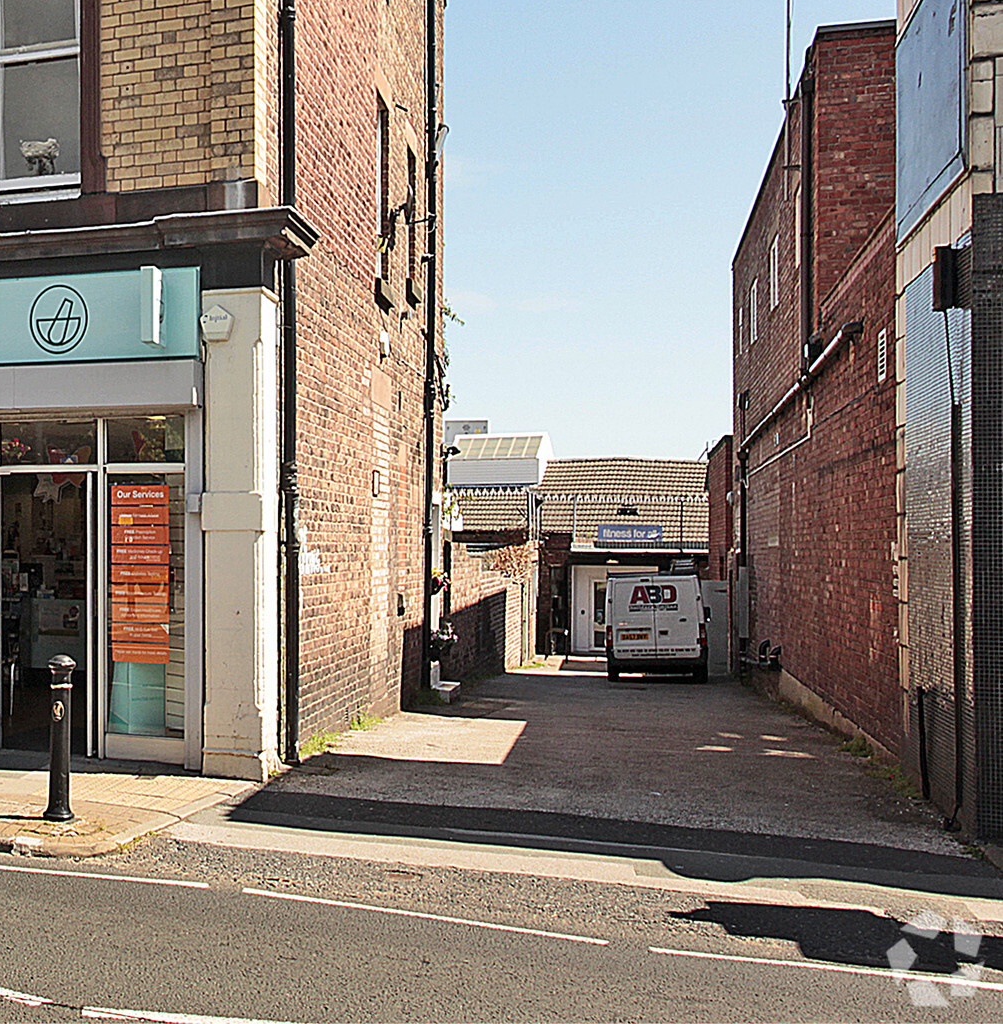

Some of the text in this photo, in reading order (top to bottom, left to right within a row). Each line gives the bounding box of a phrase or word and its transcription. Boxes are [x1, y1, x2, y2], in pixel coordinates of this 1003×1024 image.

[116, 490, 164, 498] Our Services
[602, 528, 632, 538] fitness
[633, 528, 646, 538] for
[629, 584, 678, 605] ABD
